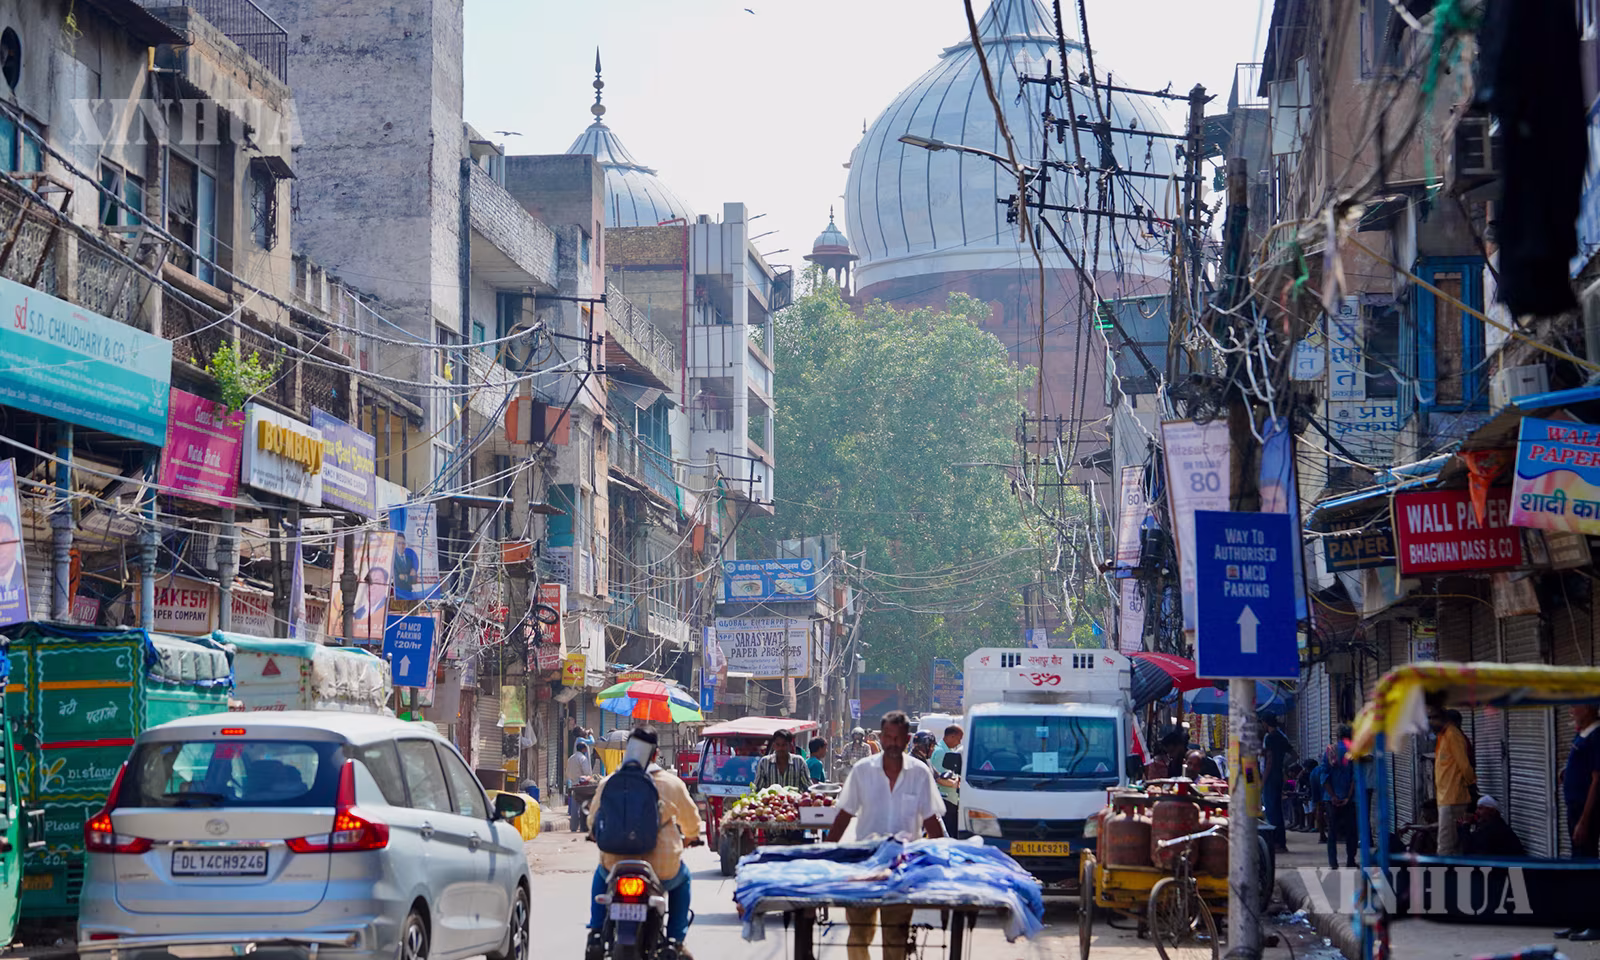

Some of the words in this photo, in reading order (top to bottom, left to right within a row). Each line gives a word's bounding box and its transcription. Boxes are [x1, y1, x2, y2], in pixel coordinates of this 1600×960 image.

[49, 317, 103, 362] CHAUDHARY
[104, 337, 111, 358] &
[1548, 426, 1600, 447] WAL
[258, 420, 324, 477] BOMBAY
[1520, 489, 1567, 516] शादी
[1406, 503, 1453, 534] WALL
[1225, 528, 1249, 545] WAY
[1214, 544, 1277, 562] AUTHORISED
[1328, 537, 1389, 559] PAPER
[1409, 541, 1459, 564] BHAGWAN
[1461, 540, 1487, 561] DASS
[1489, 540, 1497, 559] &
[1499, 538, 1513, 558] CO
[1242, 564, 1267, 581] MCD
[1224, 582, 1270, 599] PARKING
[154, 609, 173, 620] APER
[175, 610, 206, 621] COMPANY
[231, 616, 243, 625] APER
[245, 616, 266, 627] COMPANY
[305, 604, 325, 625] ARDS
[719, 619, 747, 628] GLOBAL
[751, 618, 798, 627] ENTERPRES
[396, 630, 422, 640] PARKING
[408, 622, 422, 632] MCD
[735, 632, 786, 648] SARASWAT
[730, 647, 758, 658] PAPER
[181, 854, 264, 869] DL14CH9246
